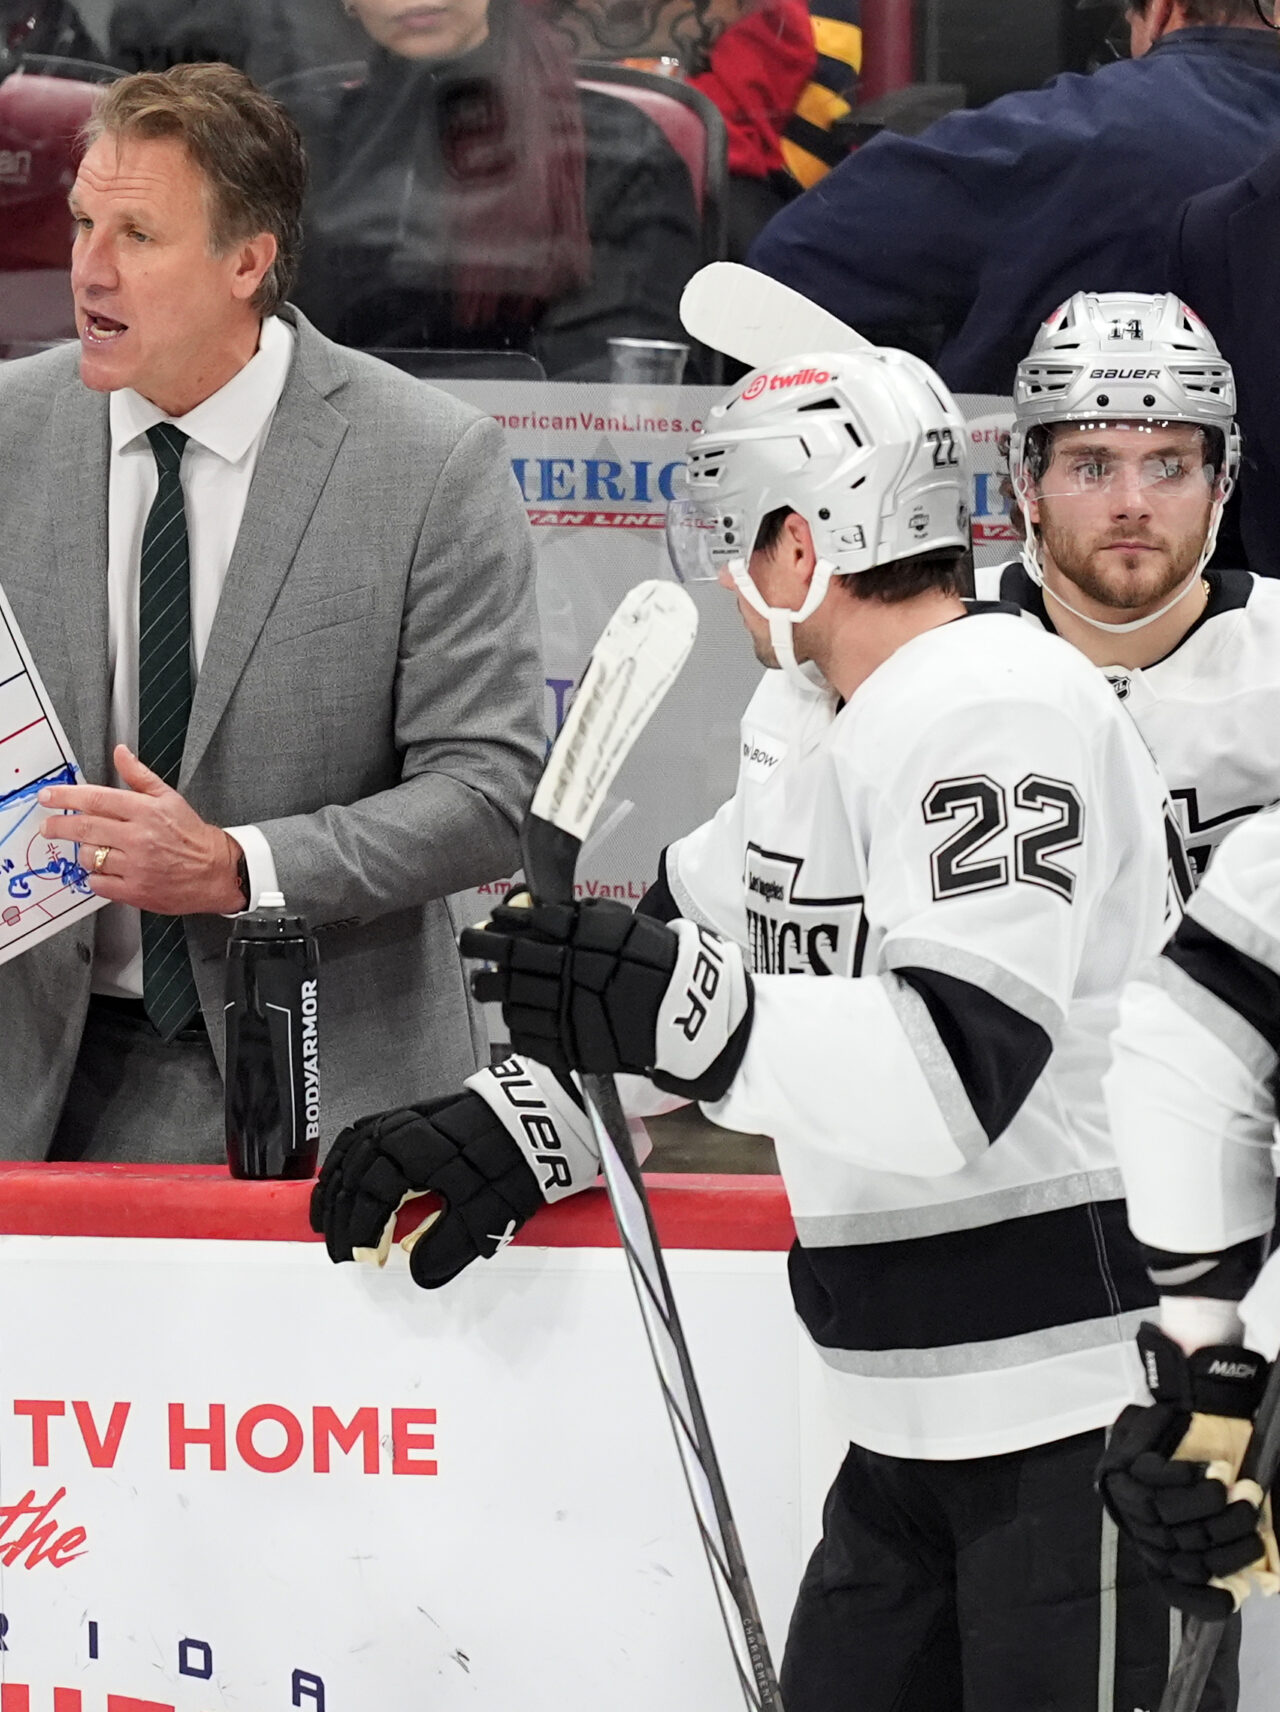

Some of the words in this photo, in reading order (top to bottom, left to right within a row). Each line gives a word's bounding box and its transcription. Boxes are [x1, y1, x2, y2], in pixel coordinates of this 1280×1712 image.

[1108, 319, 1144, 341] 14
[770, 368, 830, 390] twilio
[1089, 369, 1161, 379] BAUER
[926, 427, 959, 470] 22
[921, 773, 1086, 906] 22
[301, 978, 320, 1142] BODYARMOR
[13, 1399, 132, 1469] TV
[168, 1402, 439, 1476] HOME
